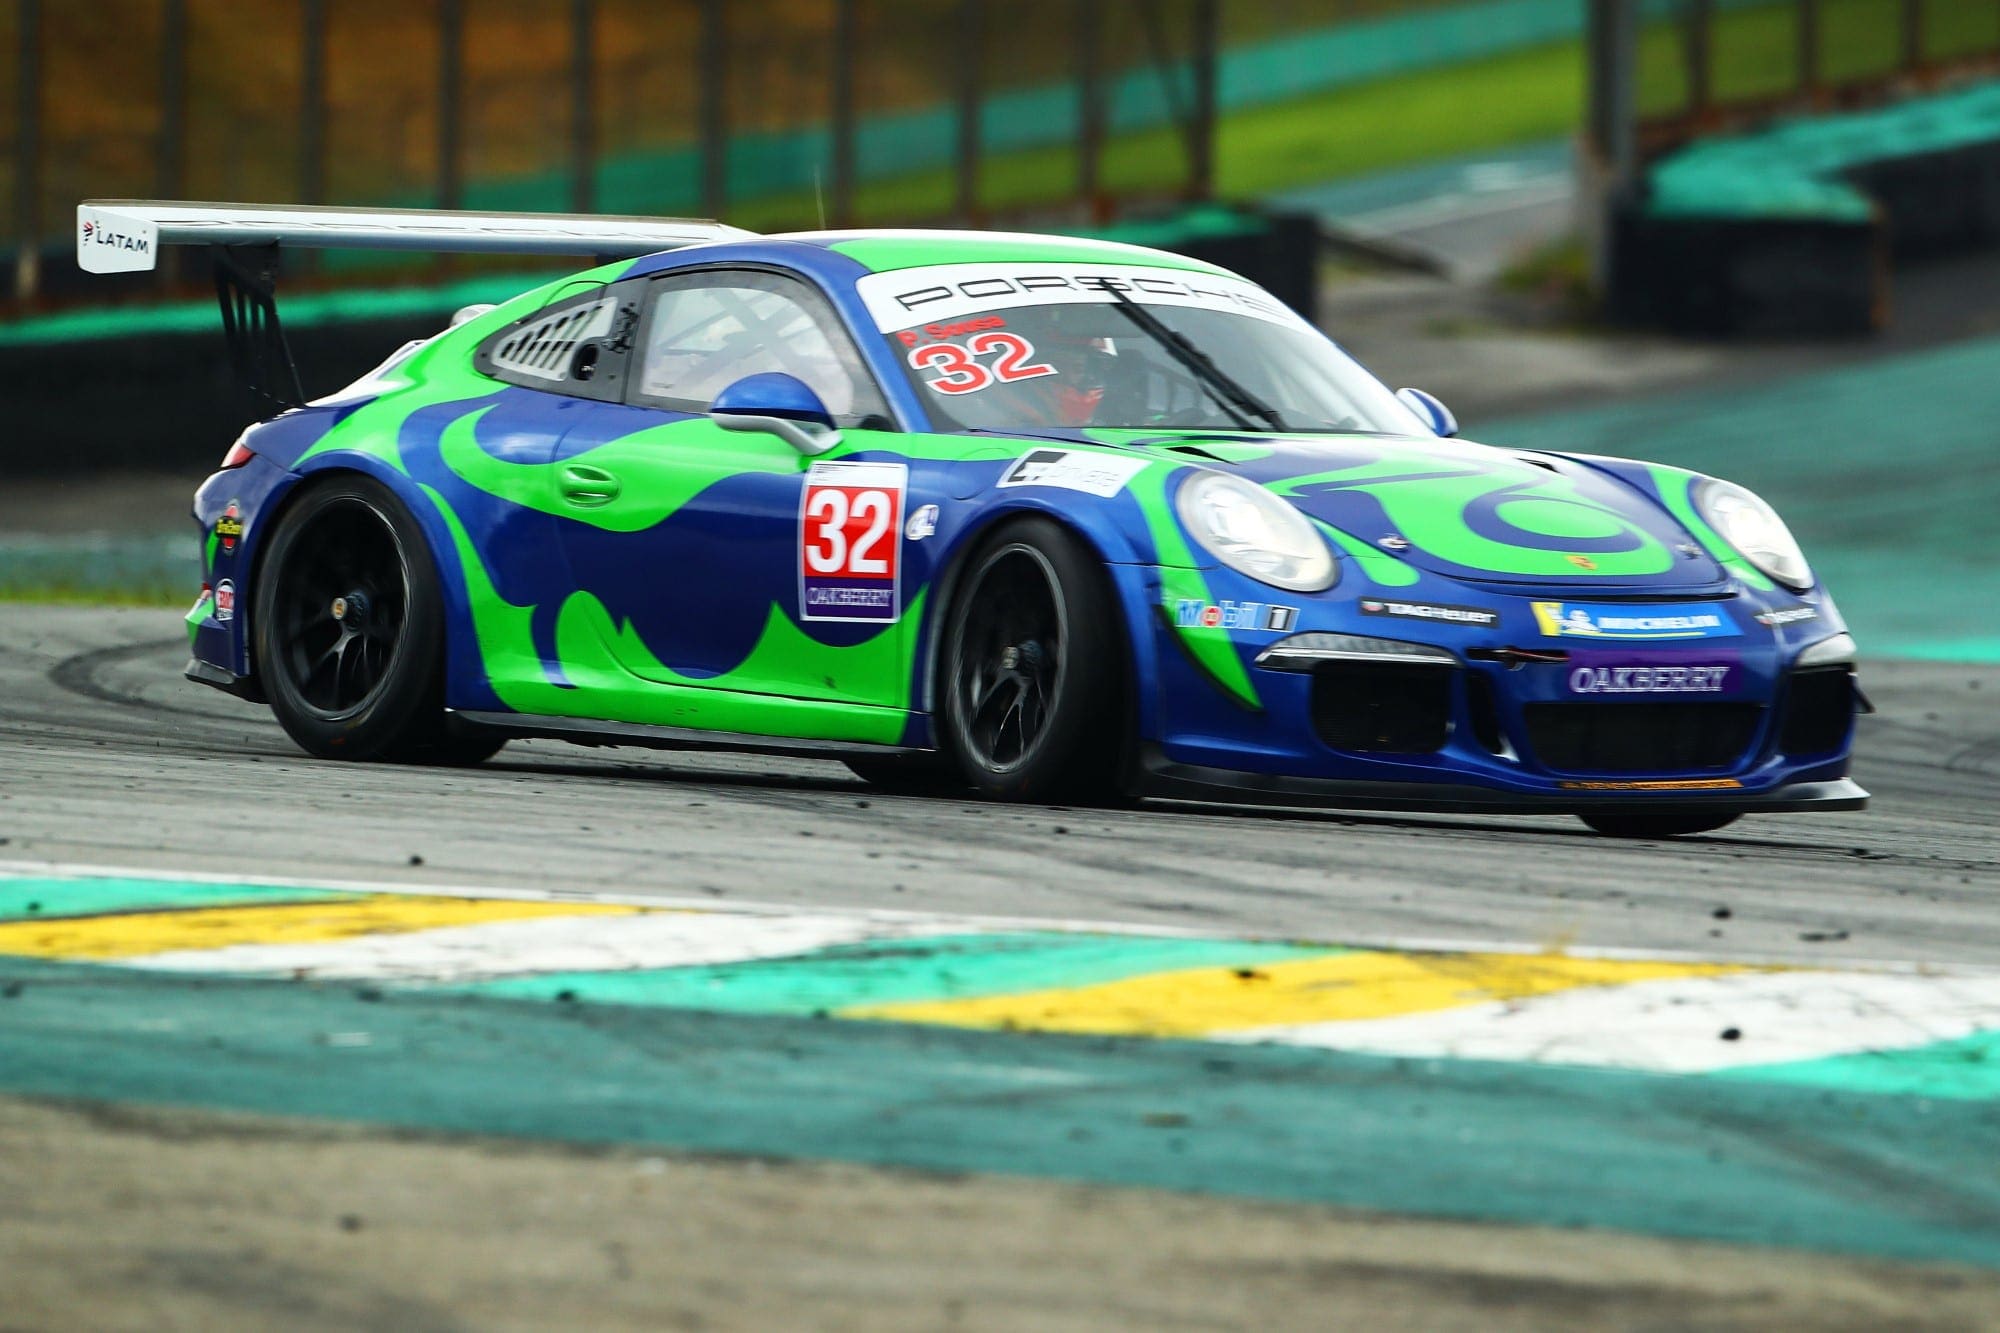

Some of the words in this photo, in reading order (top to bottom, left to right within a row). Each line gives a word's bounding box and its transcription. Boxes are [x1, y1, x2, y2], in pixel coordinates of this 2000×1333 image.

[97, 230, 149, 254] LATAM
[894, 276, 1291, 321] PORSCHE
[908, 332, 1059, 395] 32
[806, 489, 892, 574] 32
[807, 587, 895, 607] OAKBERRY
[1174, 599, 1264, 630] Mobil
[1568, 666, 1730, 693] OAKBERRY
